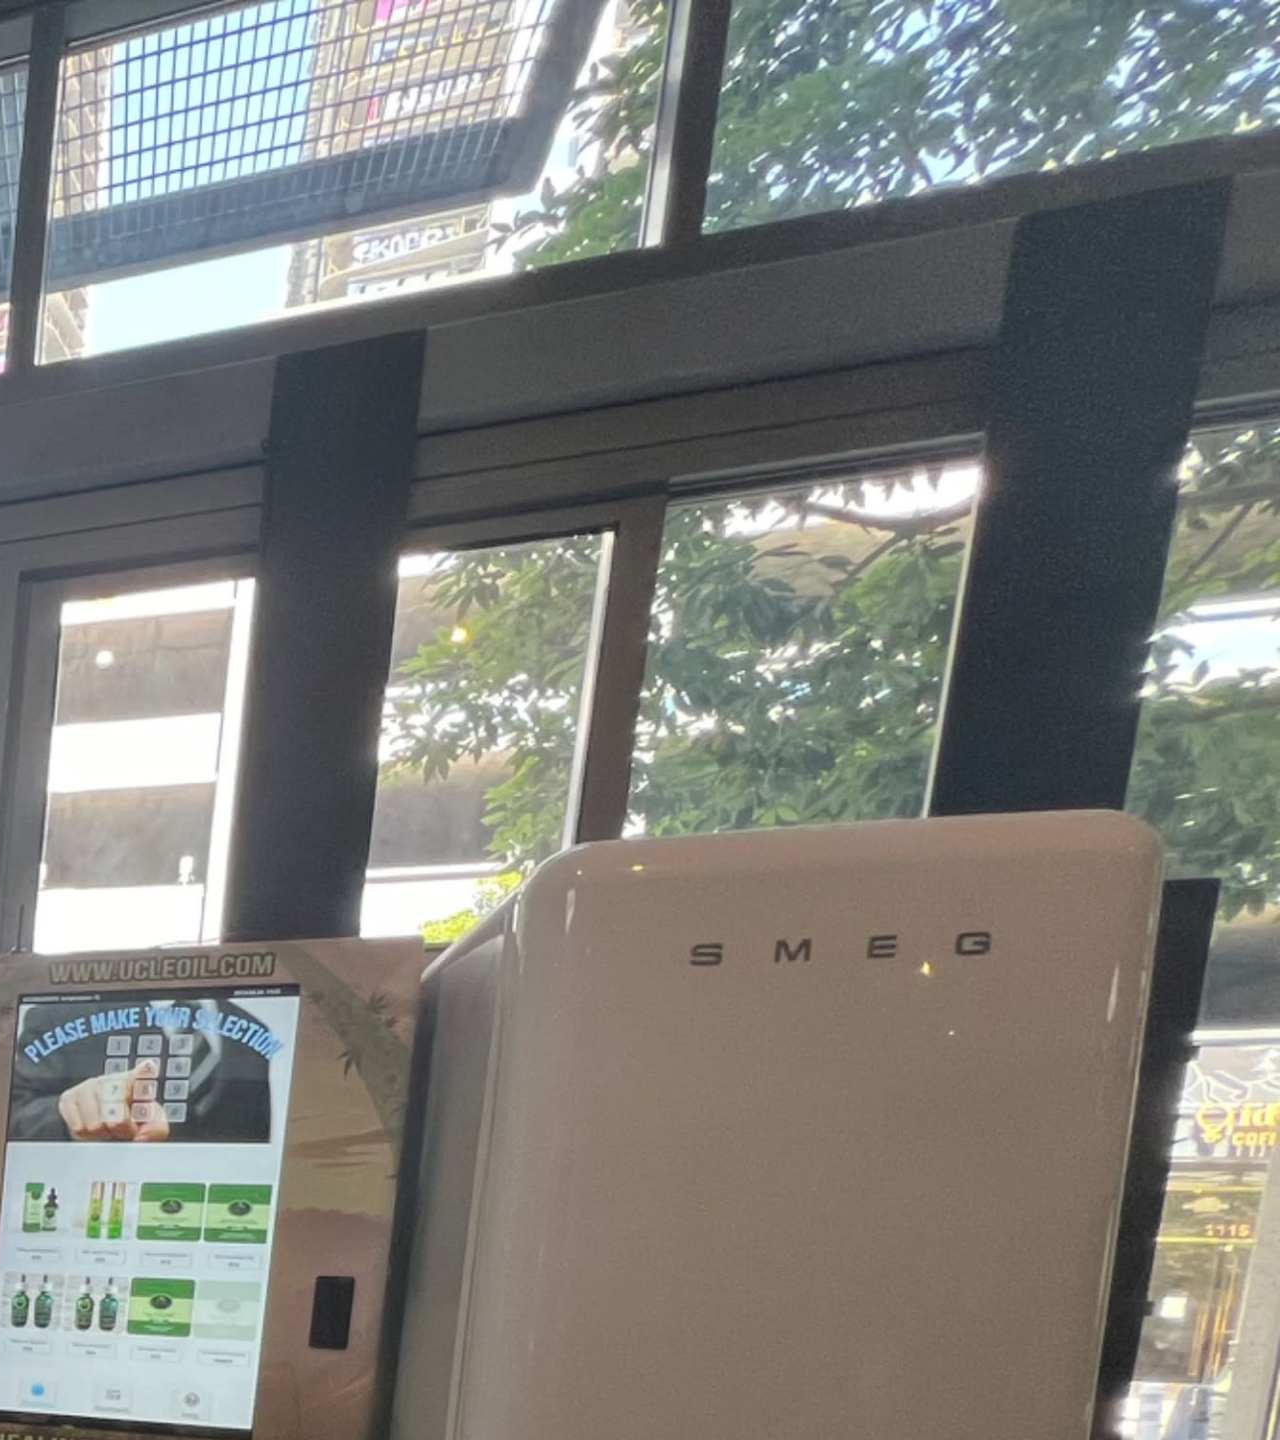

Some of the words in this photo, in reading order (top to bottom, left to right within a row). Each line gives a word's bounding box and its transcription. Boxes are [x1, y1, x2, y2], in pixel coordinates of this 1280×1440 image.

[690, 931, 992, 966] SMEG
[49, 953, 277, 985] WWW.UCLEOIL.COM
[24, 1018, 89, 1064] PLEASE
[90, 1007, 140, 1034] MAKE
[145, 1007, 191, 1028] YOUR
[192, 1007, 285, 1060] SELECTION
